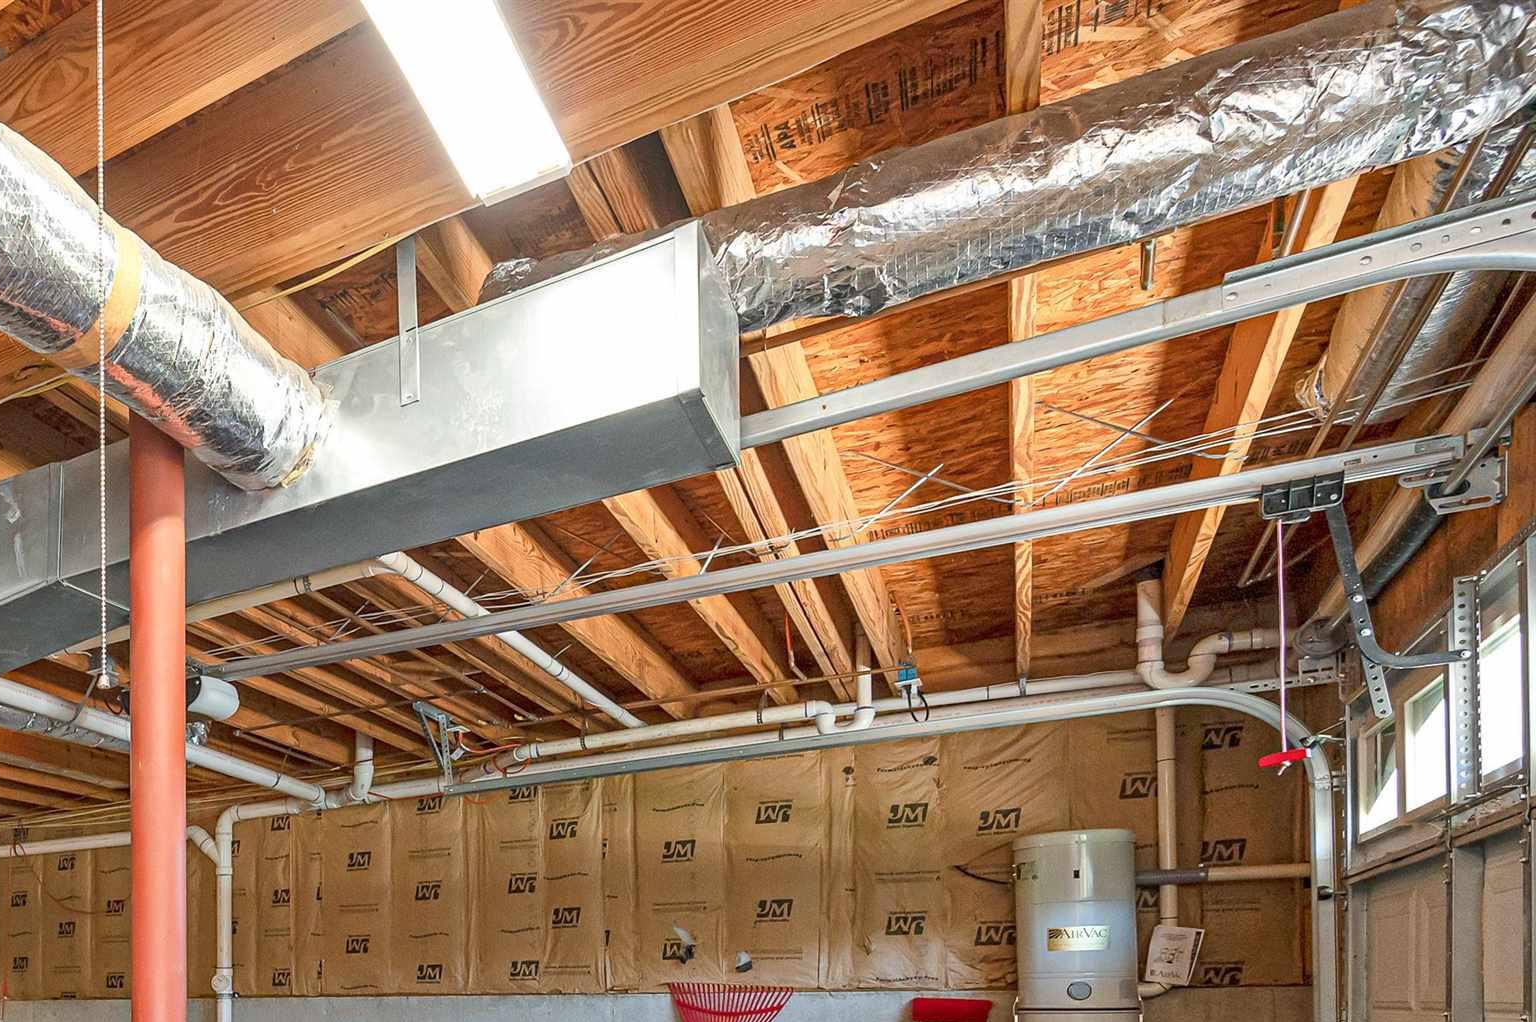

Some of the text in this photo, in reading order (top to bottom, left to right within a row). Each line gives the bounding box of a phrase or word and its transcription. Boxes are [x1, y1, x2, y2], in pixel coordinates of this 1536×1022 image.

[1120, 776, 1157, 799] M
[755, 804, 793, 824] JM
[887, 802, 929, 824] JM
[978, 808, 1022, 831] JM
[550, 821, 578, 840] JM
[662, 839, 696, 859] JM
[347, 852, 372, 867] JM
[416, 884, 441, 901] JM
[508, 876, 537, 894] JM
[552, 907, 581, 926] JM
[756, 899, 793, 918] JM
[886, 916, 926, 936] JM
[346, 936, 370, 954] JM
[416, 964, 443, 982] JM
[510, 960, 539, 978] JM
